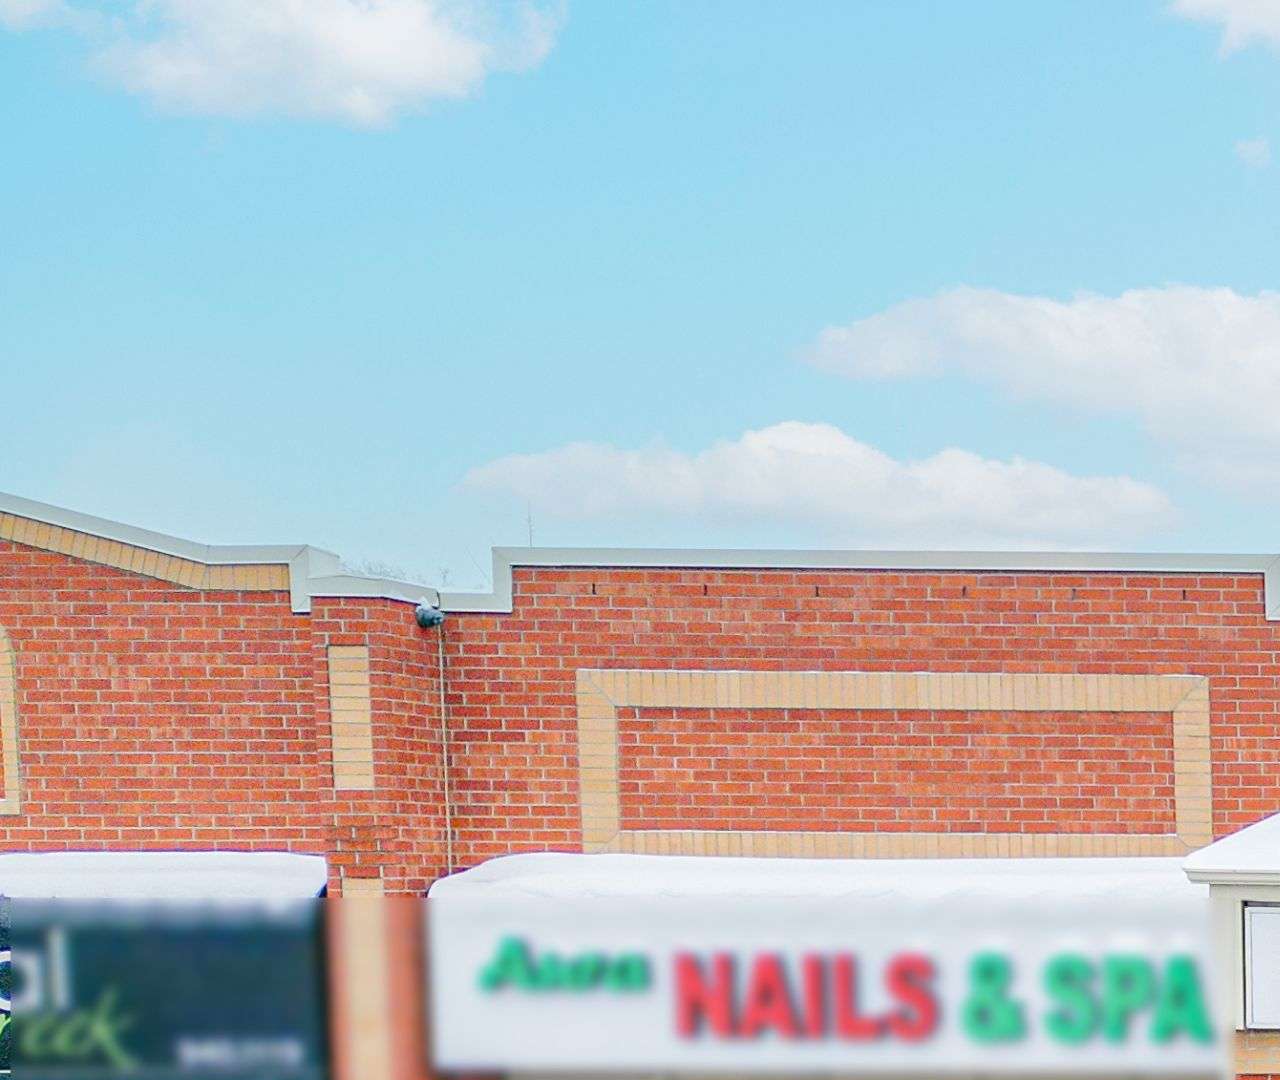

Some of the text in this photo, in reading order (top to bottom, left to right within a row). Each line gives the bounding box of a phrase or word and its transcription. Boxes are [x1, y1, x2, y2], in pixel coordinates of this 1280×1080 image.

[673, 950, 941, 1044] NAILS
[962, 951, 1028, 1046] &
[1044, 951, 1214, 1046] SPA
